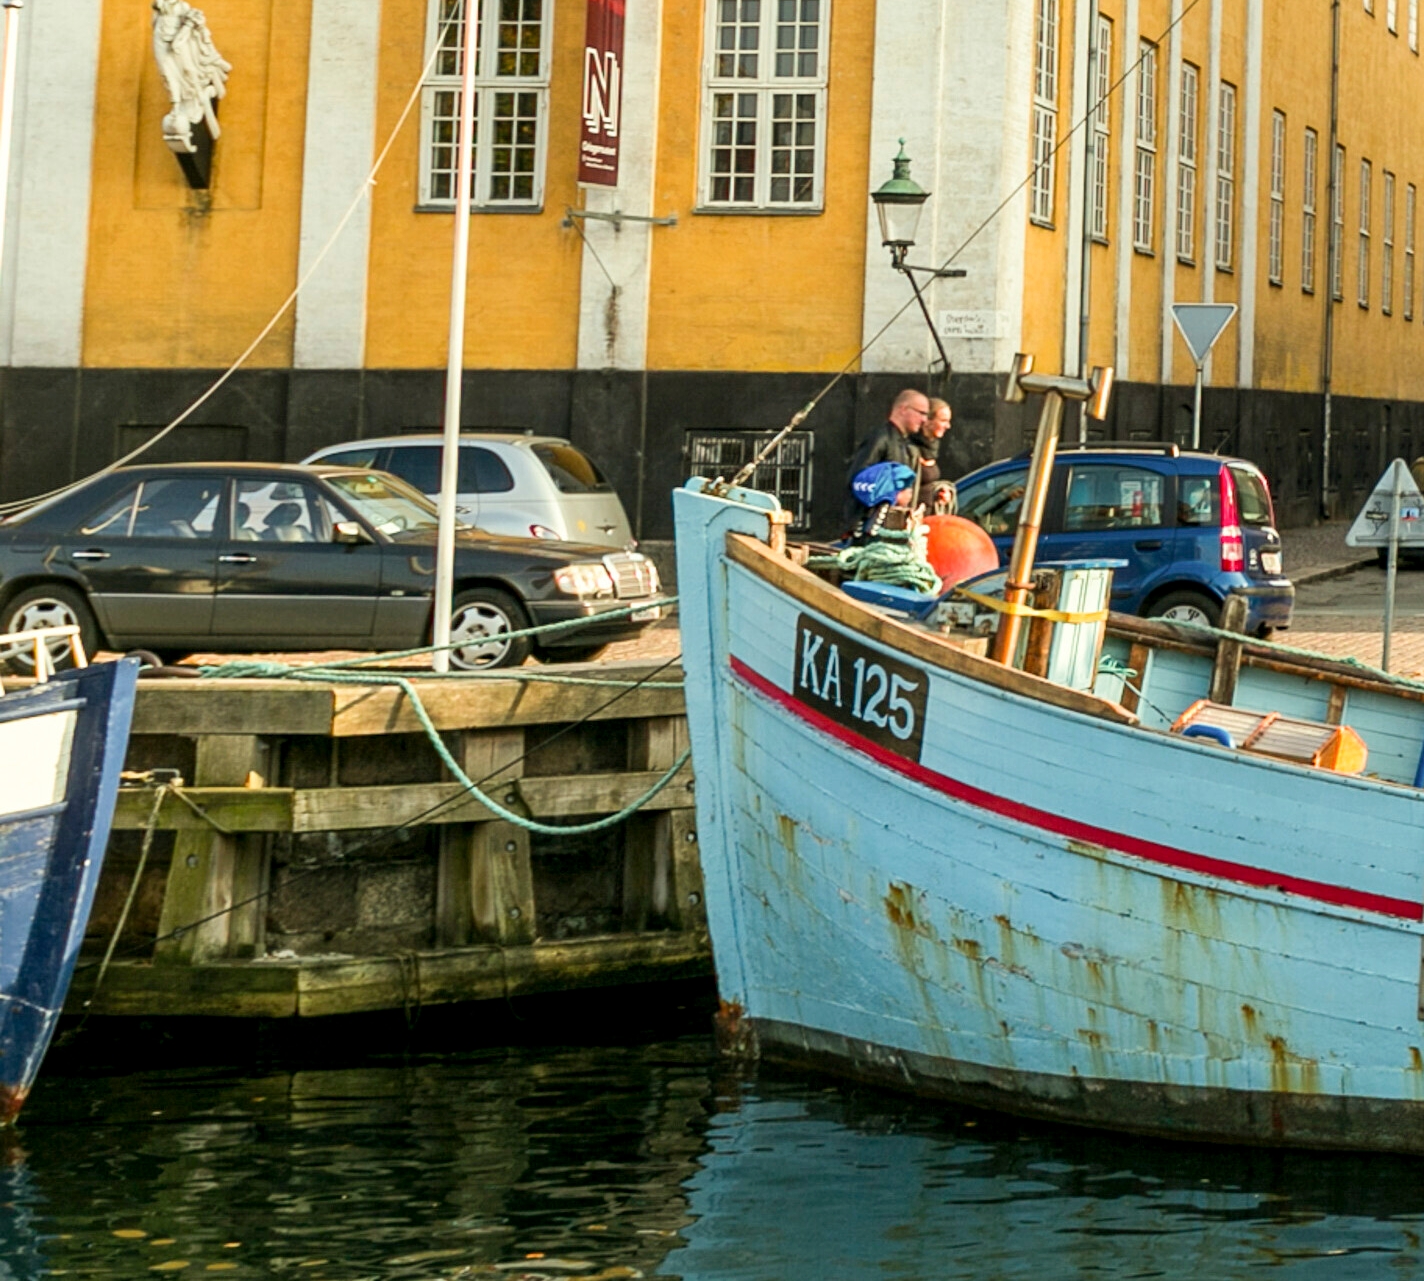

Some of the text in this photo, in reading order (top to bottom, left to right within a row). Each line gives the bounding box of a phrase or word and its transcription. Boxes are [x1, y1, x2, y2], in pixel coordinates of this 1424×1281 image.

[583, 46, 620, 137] N
[800, 628, 919, 740] KA 125
